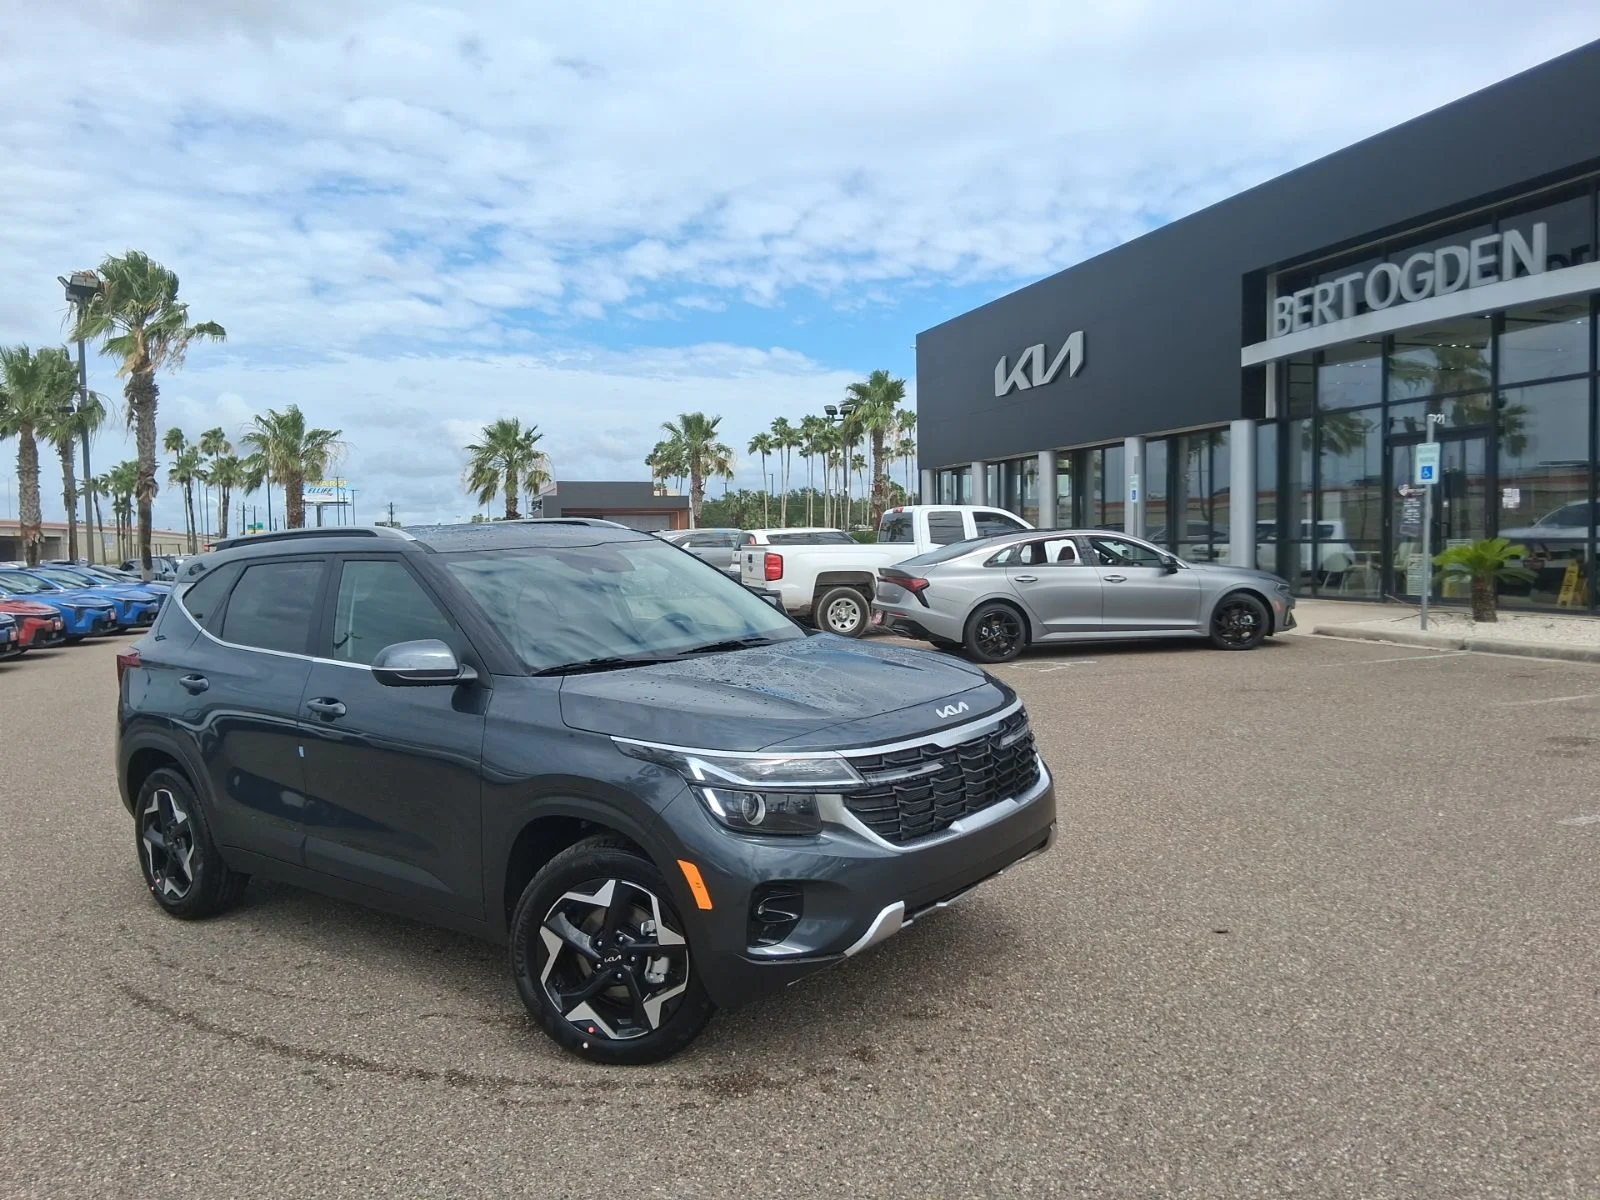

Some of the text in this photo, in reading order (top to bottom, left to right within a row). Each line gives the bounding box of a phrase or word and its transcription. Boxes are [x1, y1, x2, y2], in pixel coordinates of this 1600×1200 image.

[1274, 222, 1548, 338] BERT OGDEN
[995, 330, 1084, 397] KIA
[935, 701, 969, 719] KIA
[604, 955, 622, 963] KIA
